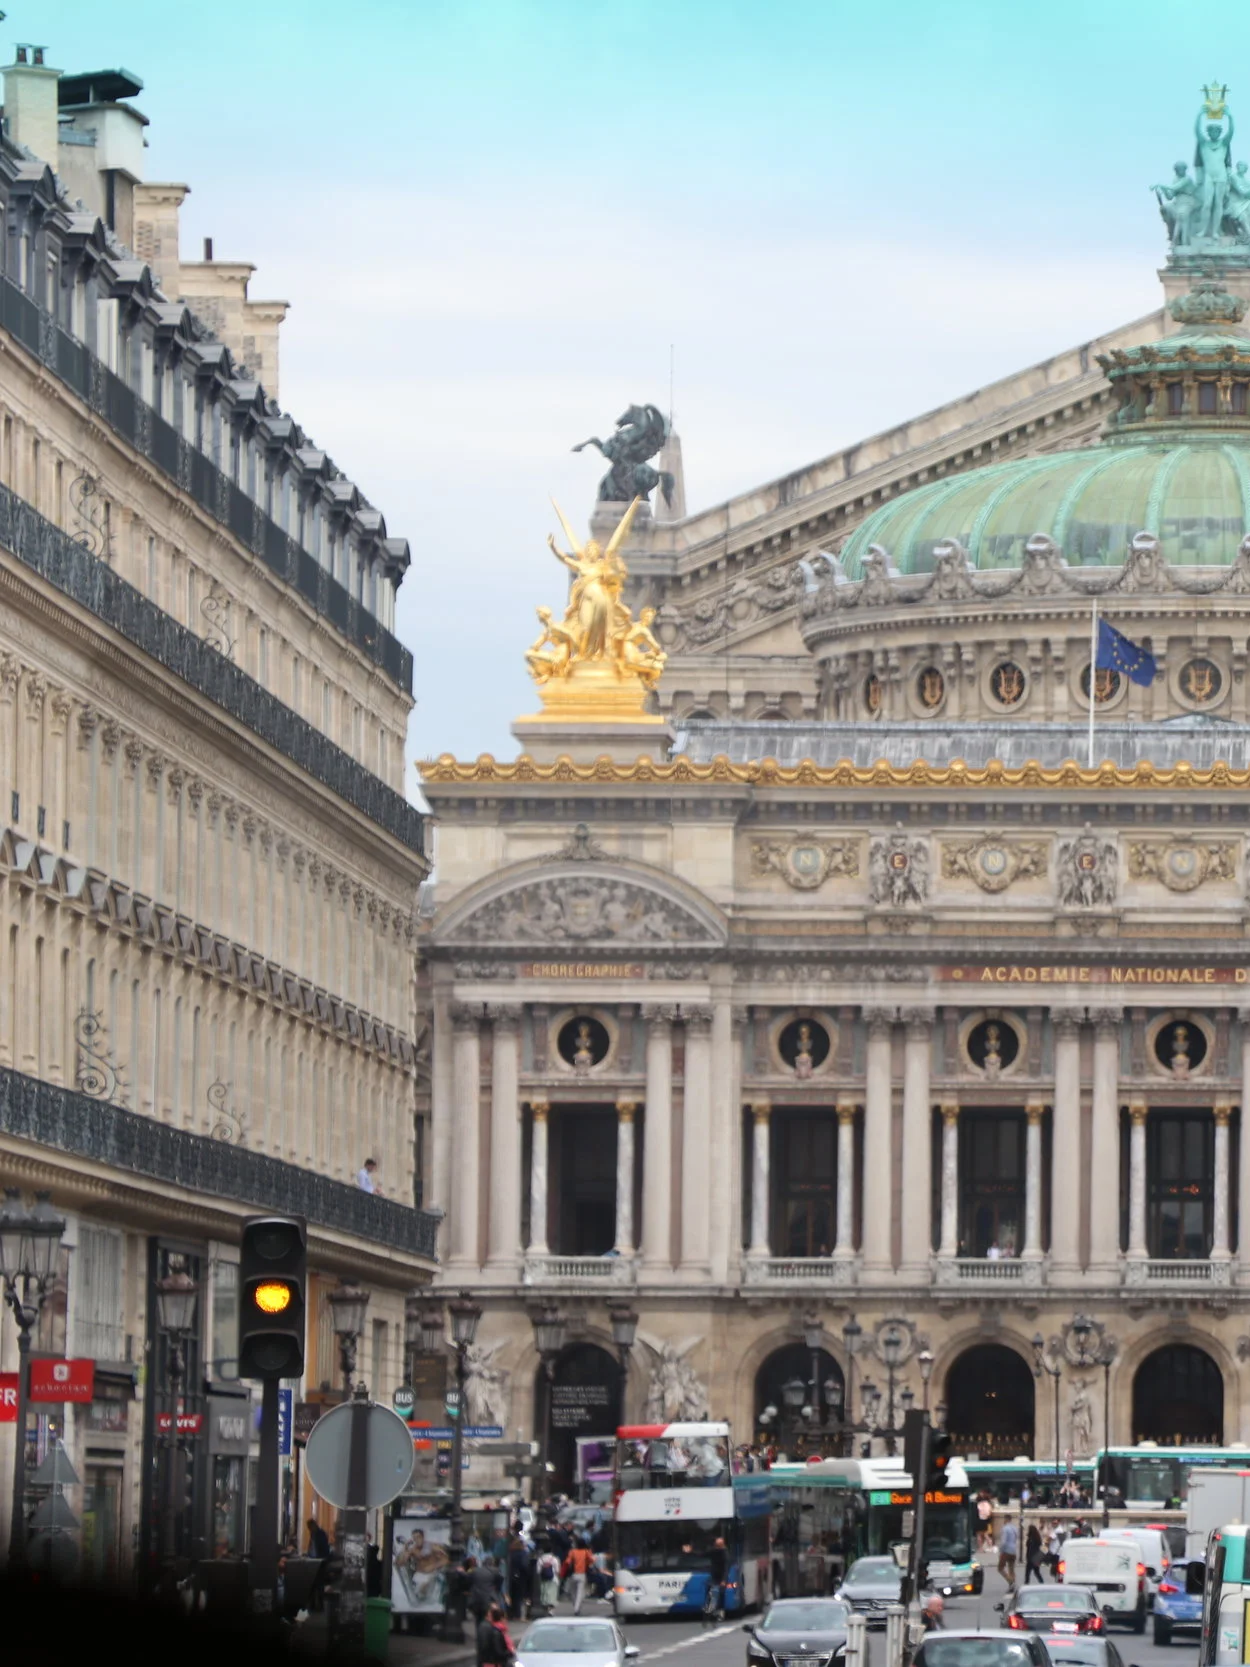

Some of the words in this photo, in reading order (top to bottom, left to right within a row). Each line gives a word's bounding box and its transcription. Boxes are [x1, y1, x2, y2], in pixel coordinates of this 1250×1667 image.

[532, 963, 632, 977] CHOREGRAPHIE
[980, 967, 1090, 983] ACADEMIE
[1110, 967, 1216, 983] NATIONALE
[396, 1393, 412, 1403] BUS
[446, 1393, 459, 1403] BU
